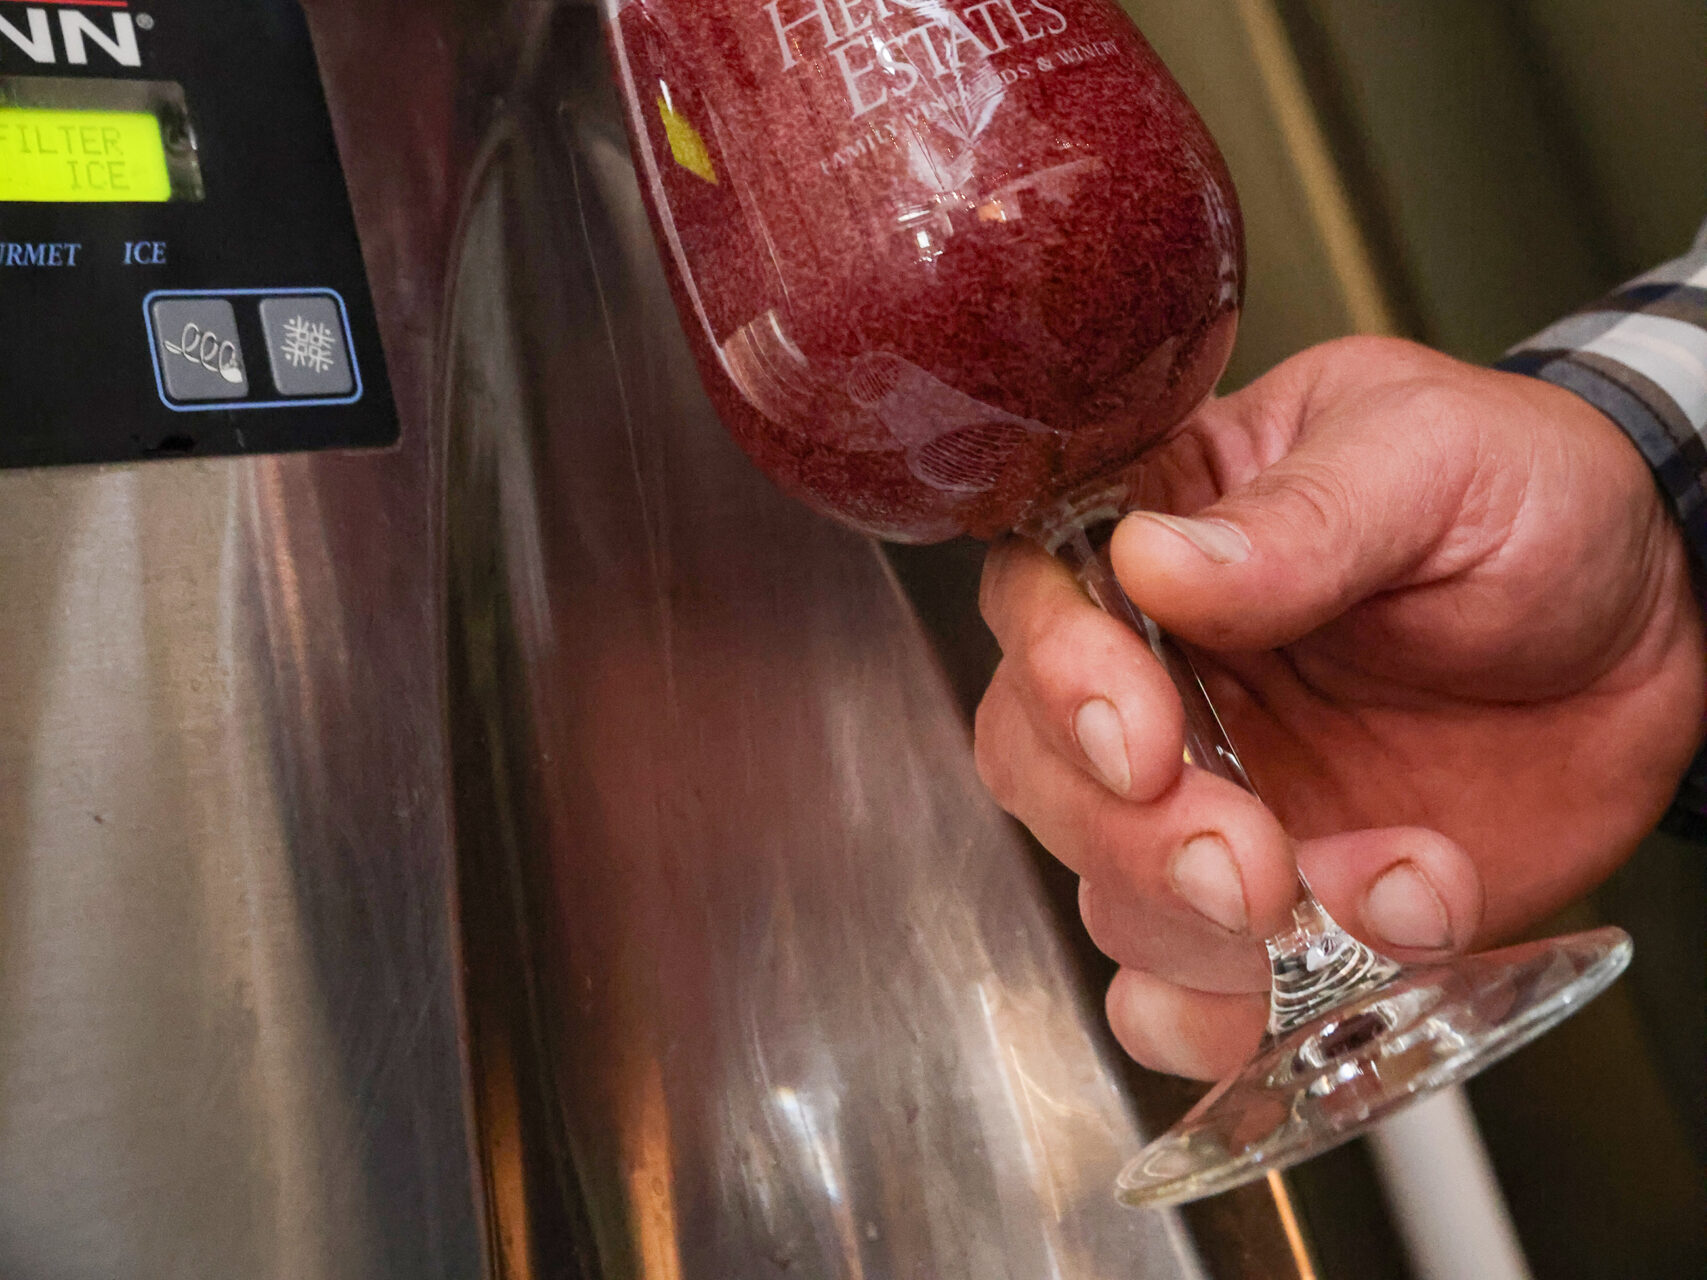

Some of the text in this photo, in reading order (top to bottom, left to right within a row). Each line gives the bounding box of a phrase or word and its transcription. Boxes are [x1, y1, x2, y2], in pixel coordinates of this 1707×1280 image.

[820, 123, 899, 176] FAMILY
[1036, 55, 1053, 72] &
[1055, 39, 1121, 66] WINERY
[68, 160, 131, 192] ICE
[123, 240, 167, 265] ICE
